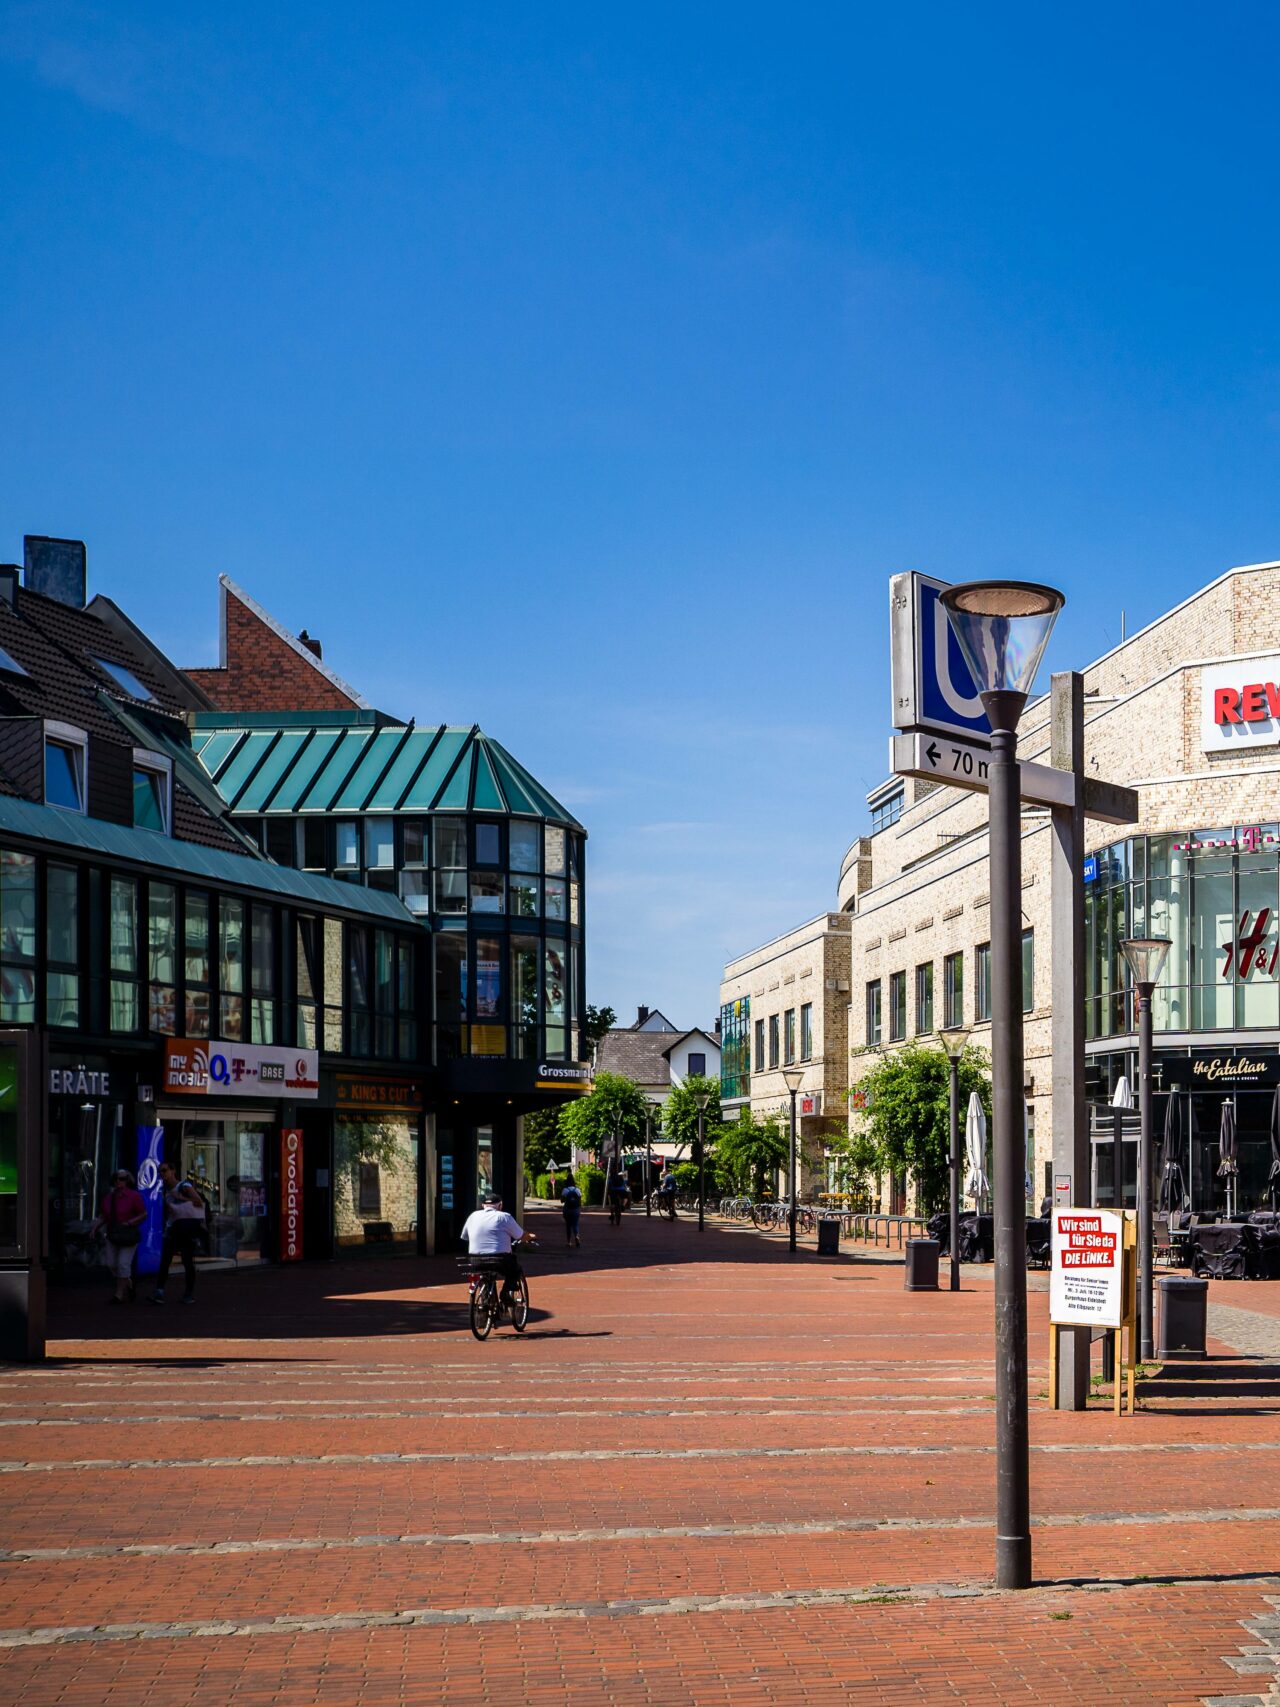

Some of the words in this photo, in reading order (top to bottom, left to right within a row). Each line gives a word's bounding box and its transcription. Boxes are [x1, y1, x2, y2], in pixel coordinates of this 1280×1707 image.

[951, 749, 974, 775] 70
[262, 1066, 283, 1079] BASE
[1193, 1061, 1209, 1075] the
[1207, 1057, 1268, 1080] Eatalian
[287, 1154, 298, 1256] vodafone
[1061, 1219, 1079, 1232] Wir
[1078, 1219, 1099, 1232] sind
[1072, 1234, 1085, 1246] für
[1086, 1234, 1102, 1247] Sie
[1102, 1236, 1114, 1247] da
[1065, 1253, 1081, 1264] DIE
